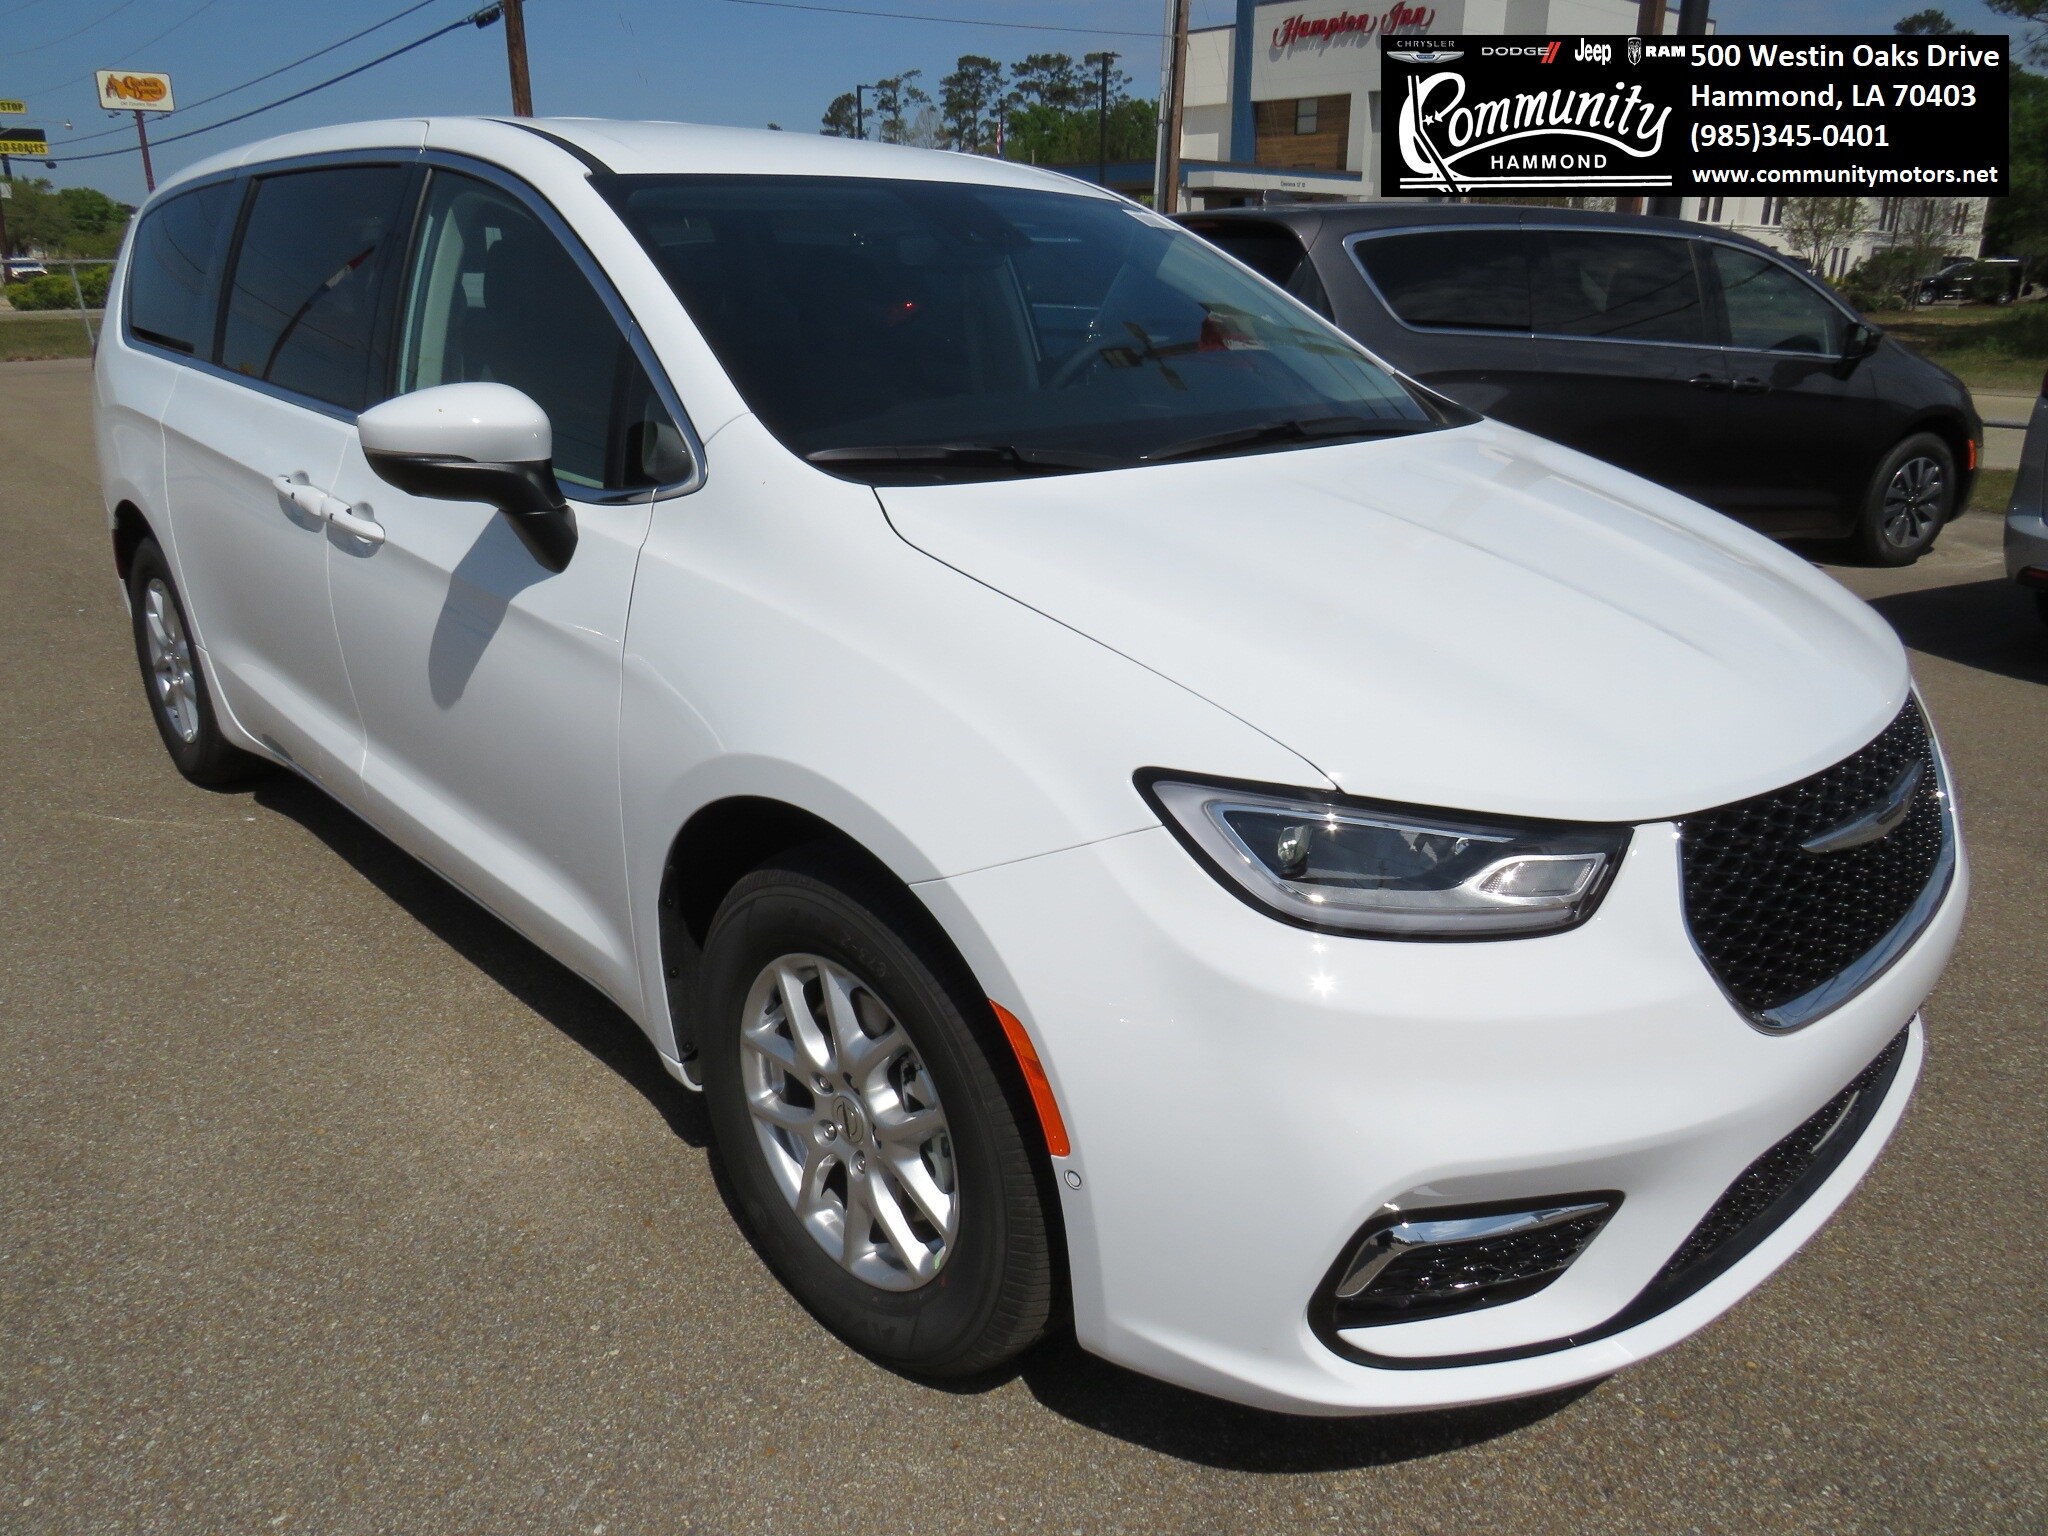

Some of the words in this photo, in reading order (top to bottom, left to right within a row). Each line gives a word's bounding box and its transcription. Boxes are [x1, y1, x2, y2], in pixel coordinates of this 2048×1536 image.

[1272, 11, 1378, 48] Hampton
[1380, 1, 1436, 35] Inn
[0, 102, 24, 112] STOP
